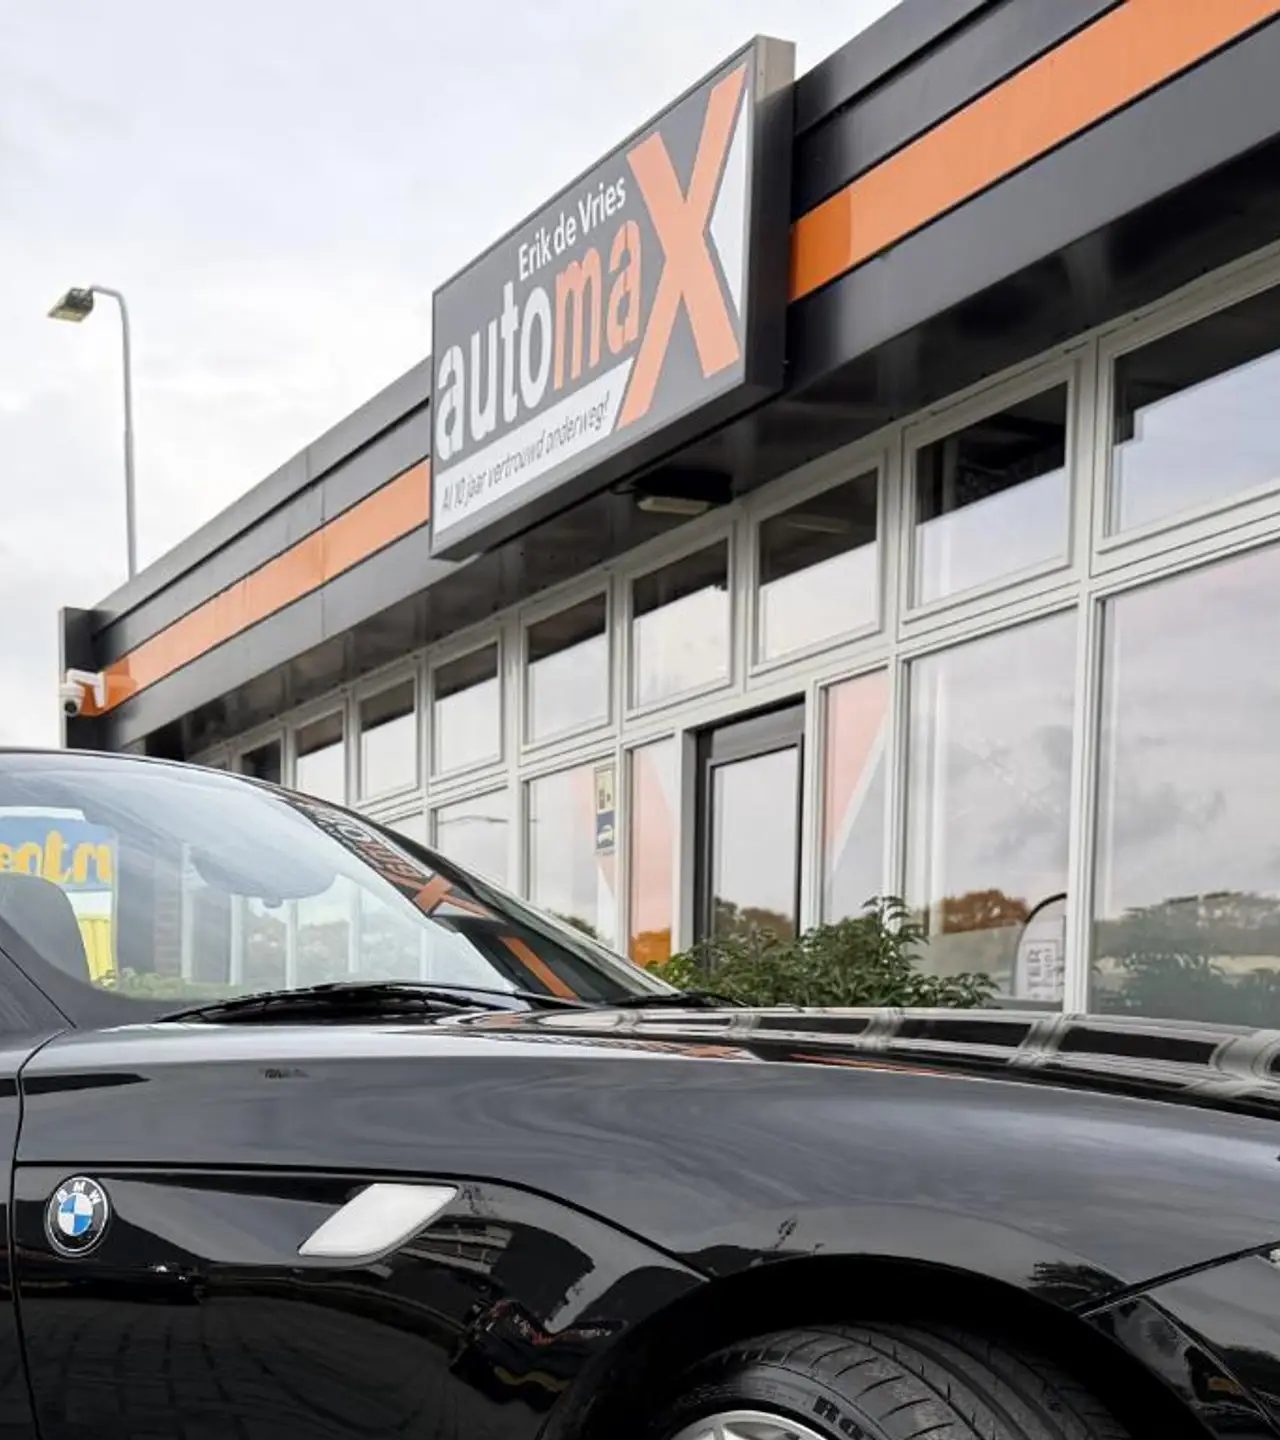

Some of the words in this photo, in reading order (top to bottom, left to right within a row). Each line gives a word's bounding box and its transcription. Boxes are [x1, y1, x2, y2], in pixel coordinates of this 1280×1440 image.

[436, 62, 747, 461] automaX
[519, 226, 551, 281] Erik
[553, 212, 577, 252] de
[578, 176, 626, 236] Vries
